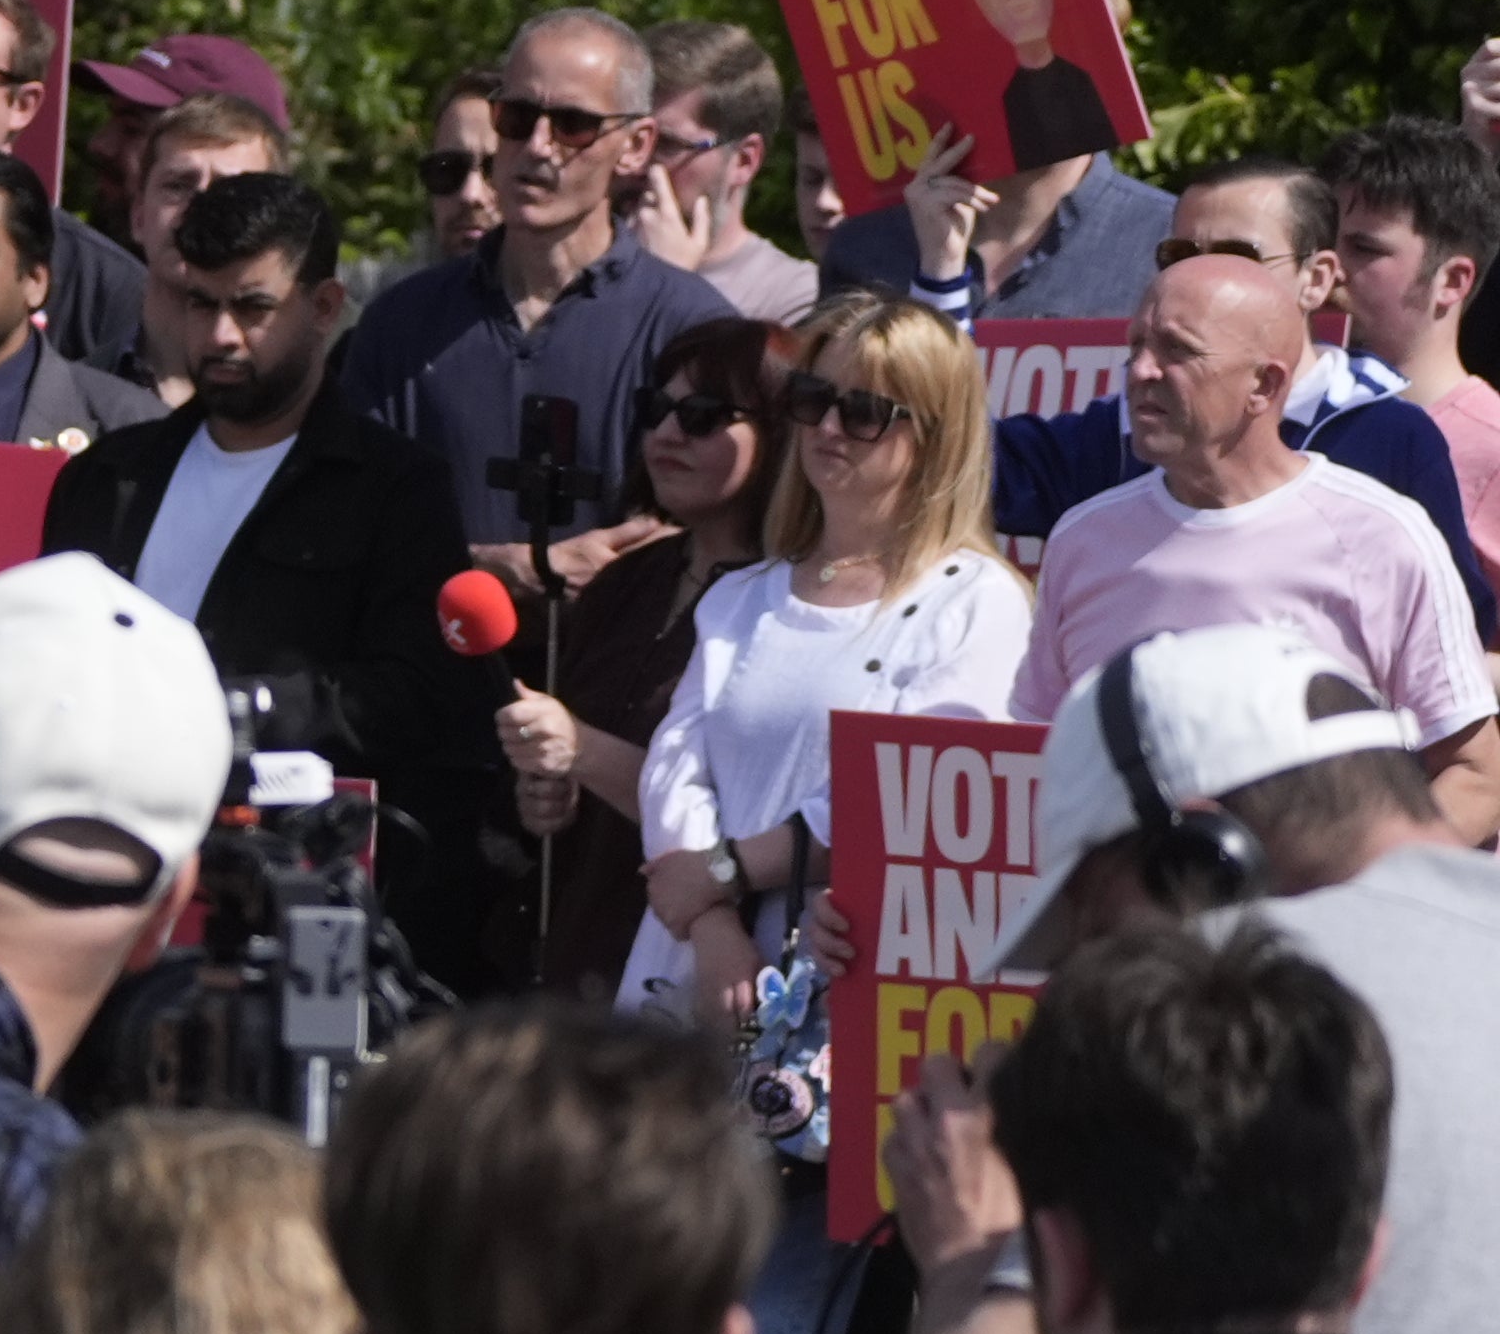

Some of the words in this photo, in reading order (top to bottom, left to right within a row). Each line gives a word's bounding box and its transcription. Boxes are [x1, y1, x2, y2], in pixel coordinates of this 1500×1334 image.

[837, 59, 933, 183] US
[977, 344, 1131, 421] VOT
[874, 742, 1041, 866] VOT
